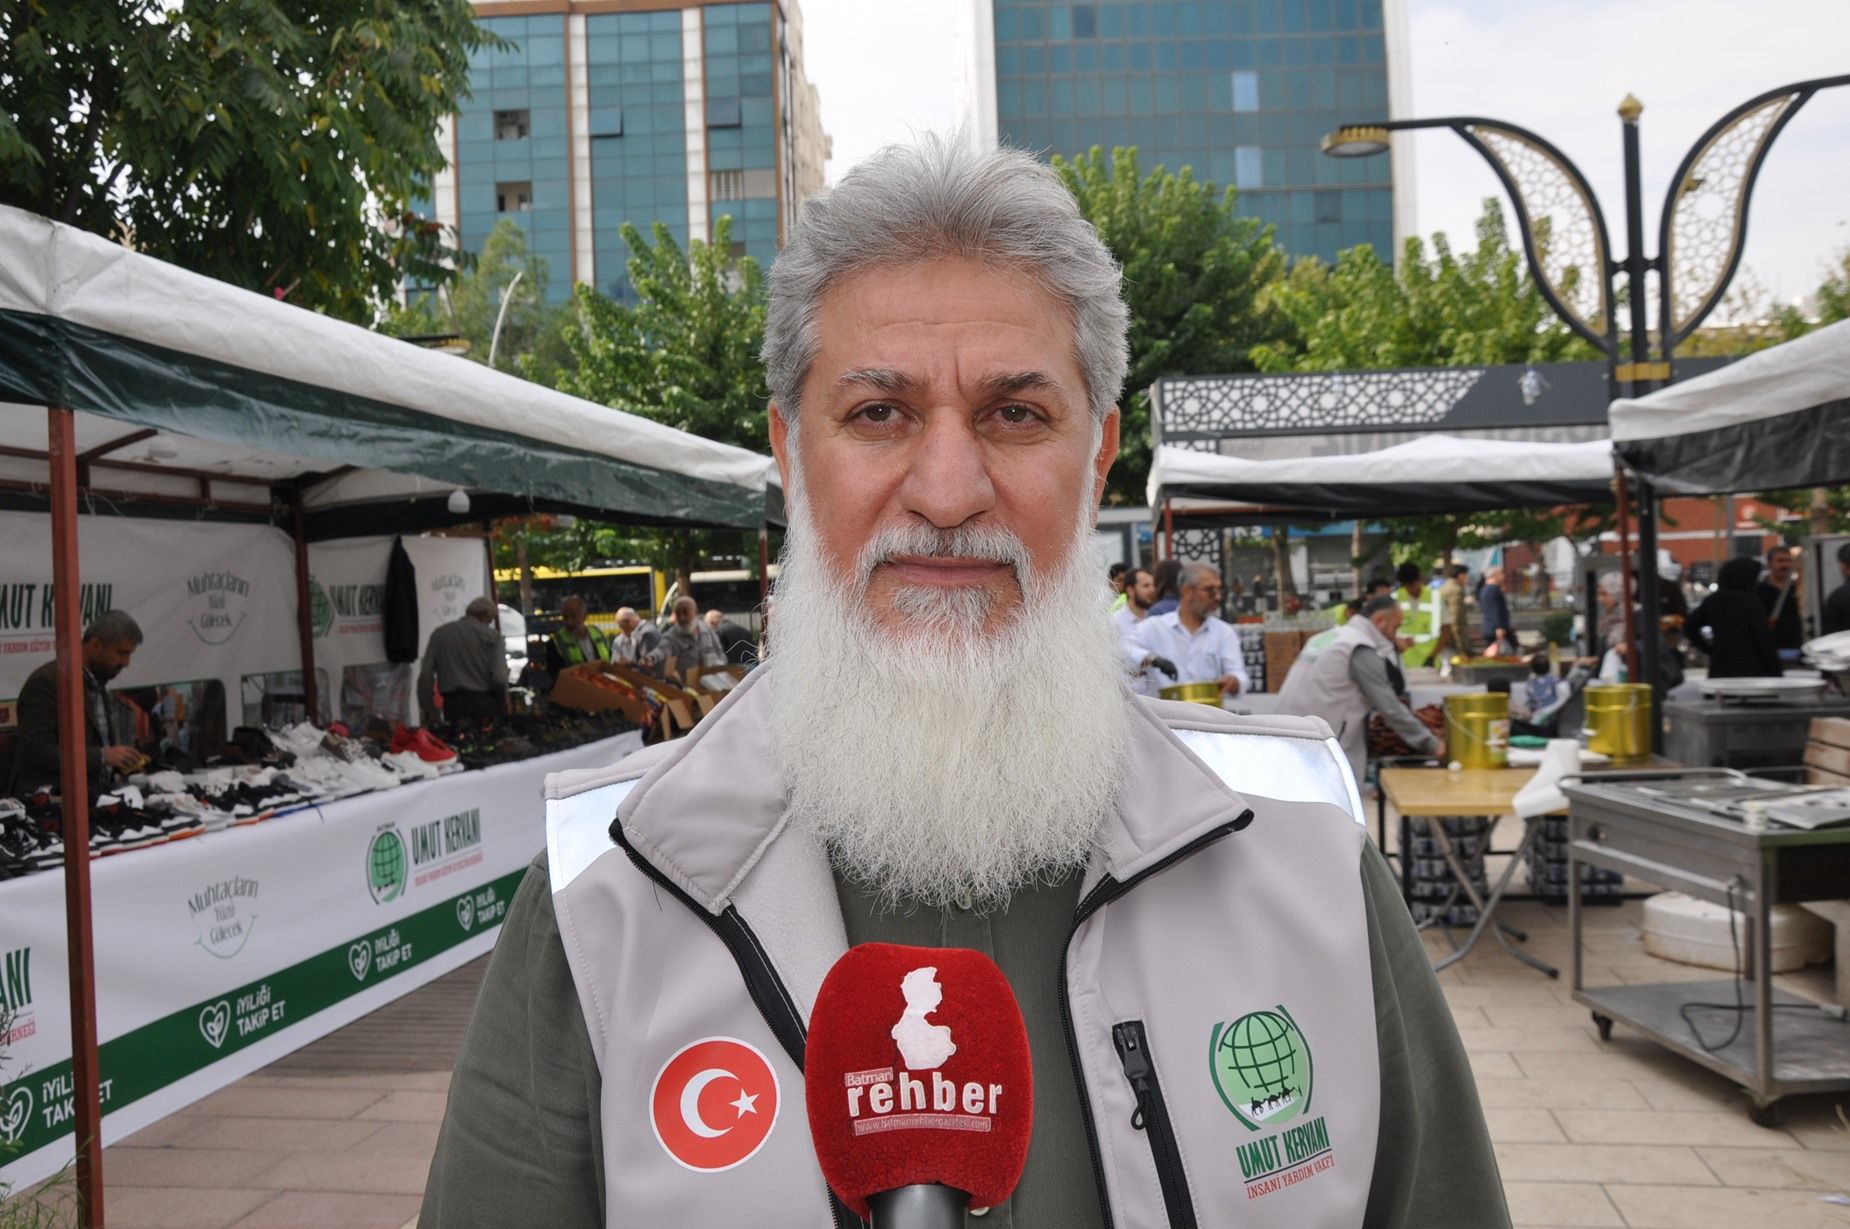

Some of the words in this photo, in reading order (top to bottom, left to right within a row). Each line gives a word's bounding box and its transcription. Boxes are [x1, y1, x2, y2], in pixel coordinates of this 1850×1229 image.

[0, 583, 36, 629] MUT
[411, 820, 441, 866] UMUT
[401, 942, 413, 962] ET
[271, 999, 287, 1021] ET
[846, 1071, 892, 1086] Batman
[847, 1072, 1003, 1118] rehber
[42, 1096, 75, 1129] TAK
[1235, 1135, 1282, 1179] UMUT
[1282, 1116, 1331, 1164] KERVANI
[1282, 1165, 1314, 1188] YARDIM
